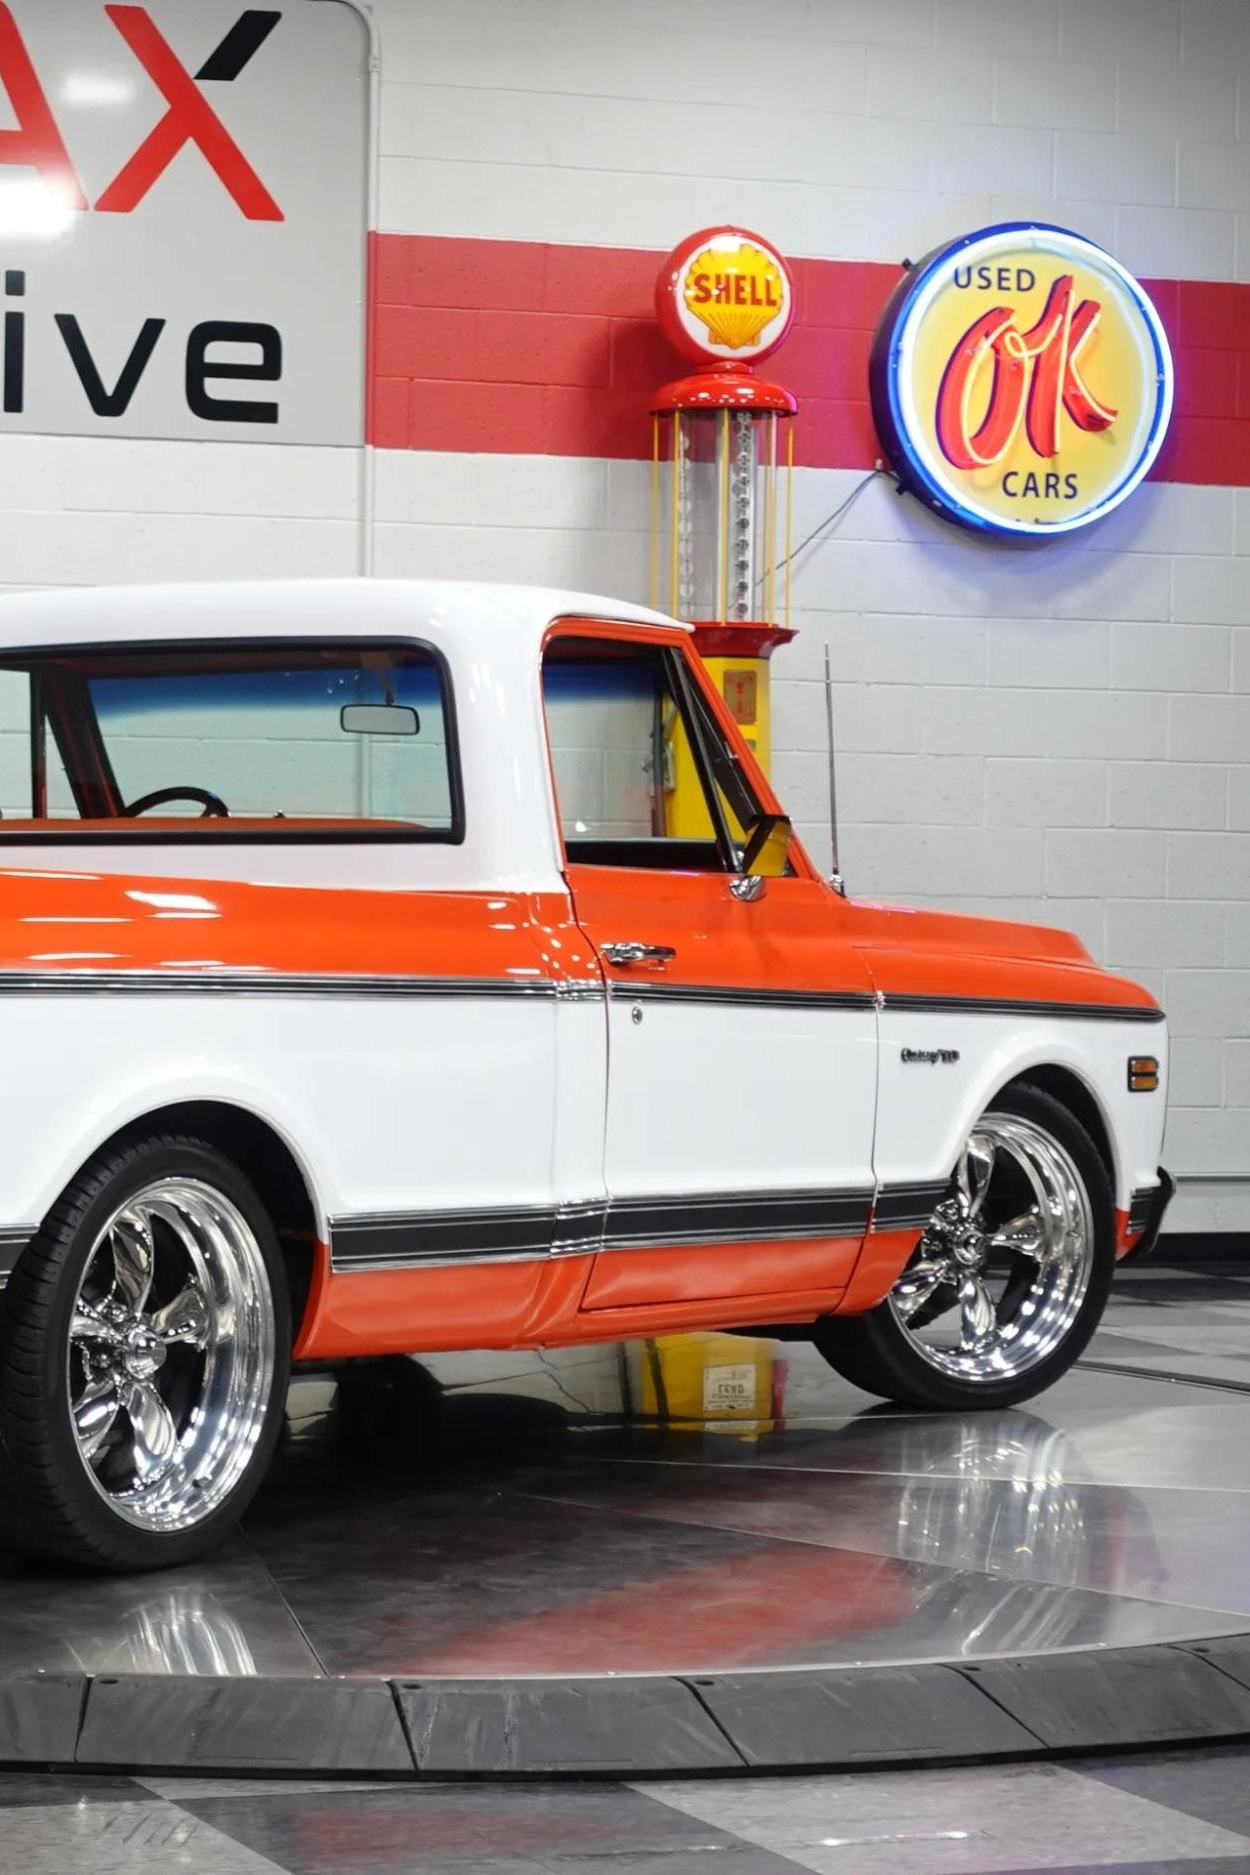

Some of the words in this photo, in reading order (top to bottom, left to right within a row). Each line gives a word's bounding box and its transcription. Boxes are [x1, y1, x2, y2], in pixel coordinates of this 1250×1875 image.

[693, 273, 777, 307] SHELL
[953, 266, 1036, 292] USED
[935, 274, 1118, 470] OK
[1002, 471, 1078, 499] CARS
